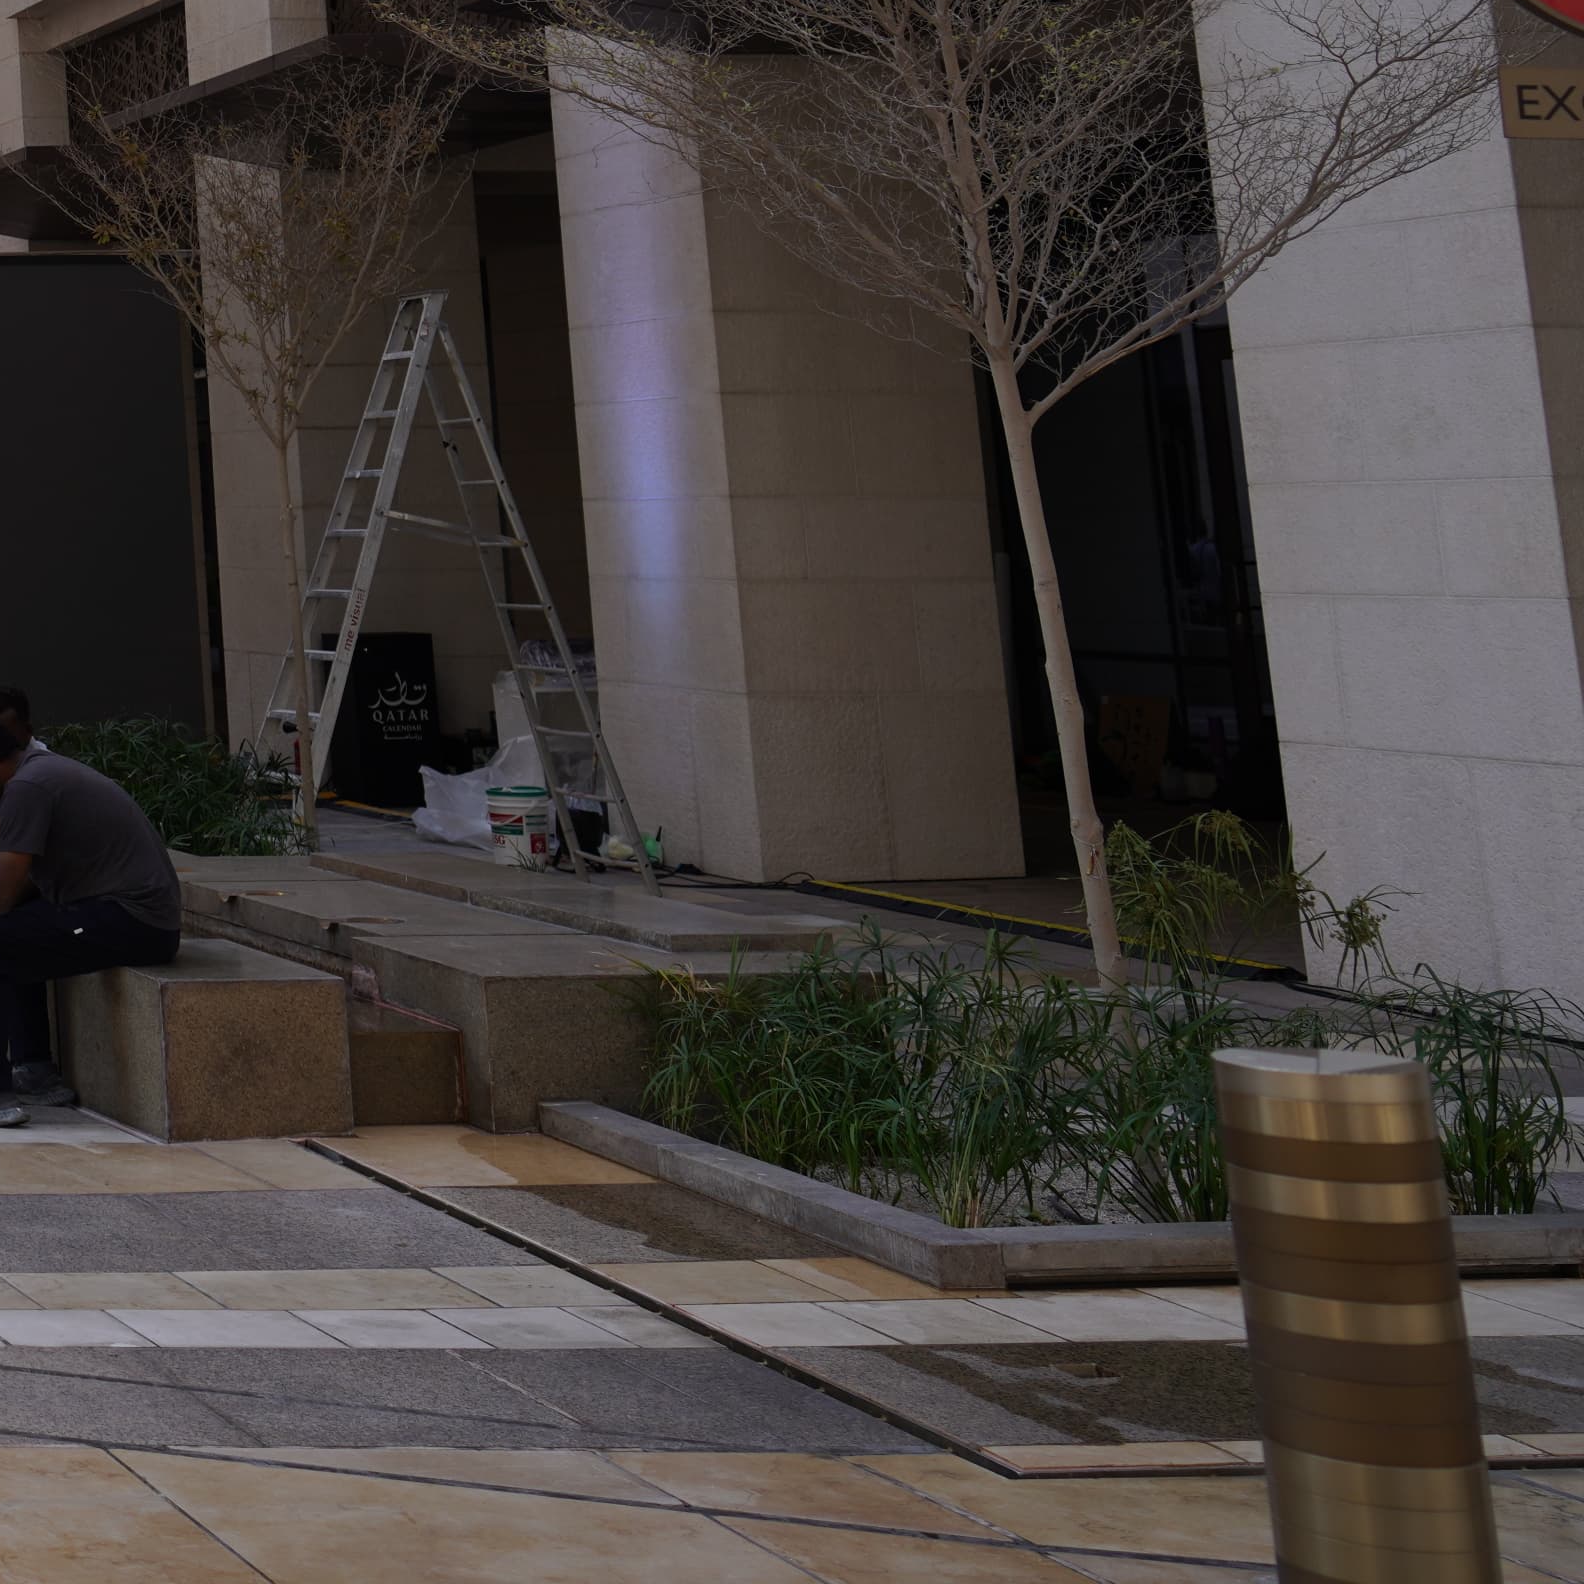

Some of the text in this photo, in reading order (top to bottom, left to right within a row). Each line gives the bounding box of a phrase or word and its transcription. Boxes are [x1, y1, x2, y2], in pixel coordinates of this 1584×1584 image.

[1517, 84, 1584, 121] EX
[372, 709, 429, 724] QATAR
[382, 724, 422, 732] CALENDAR
